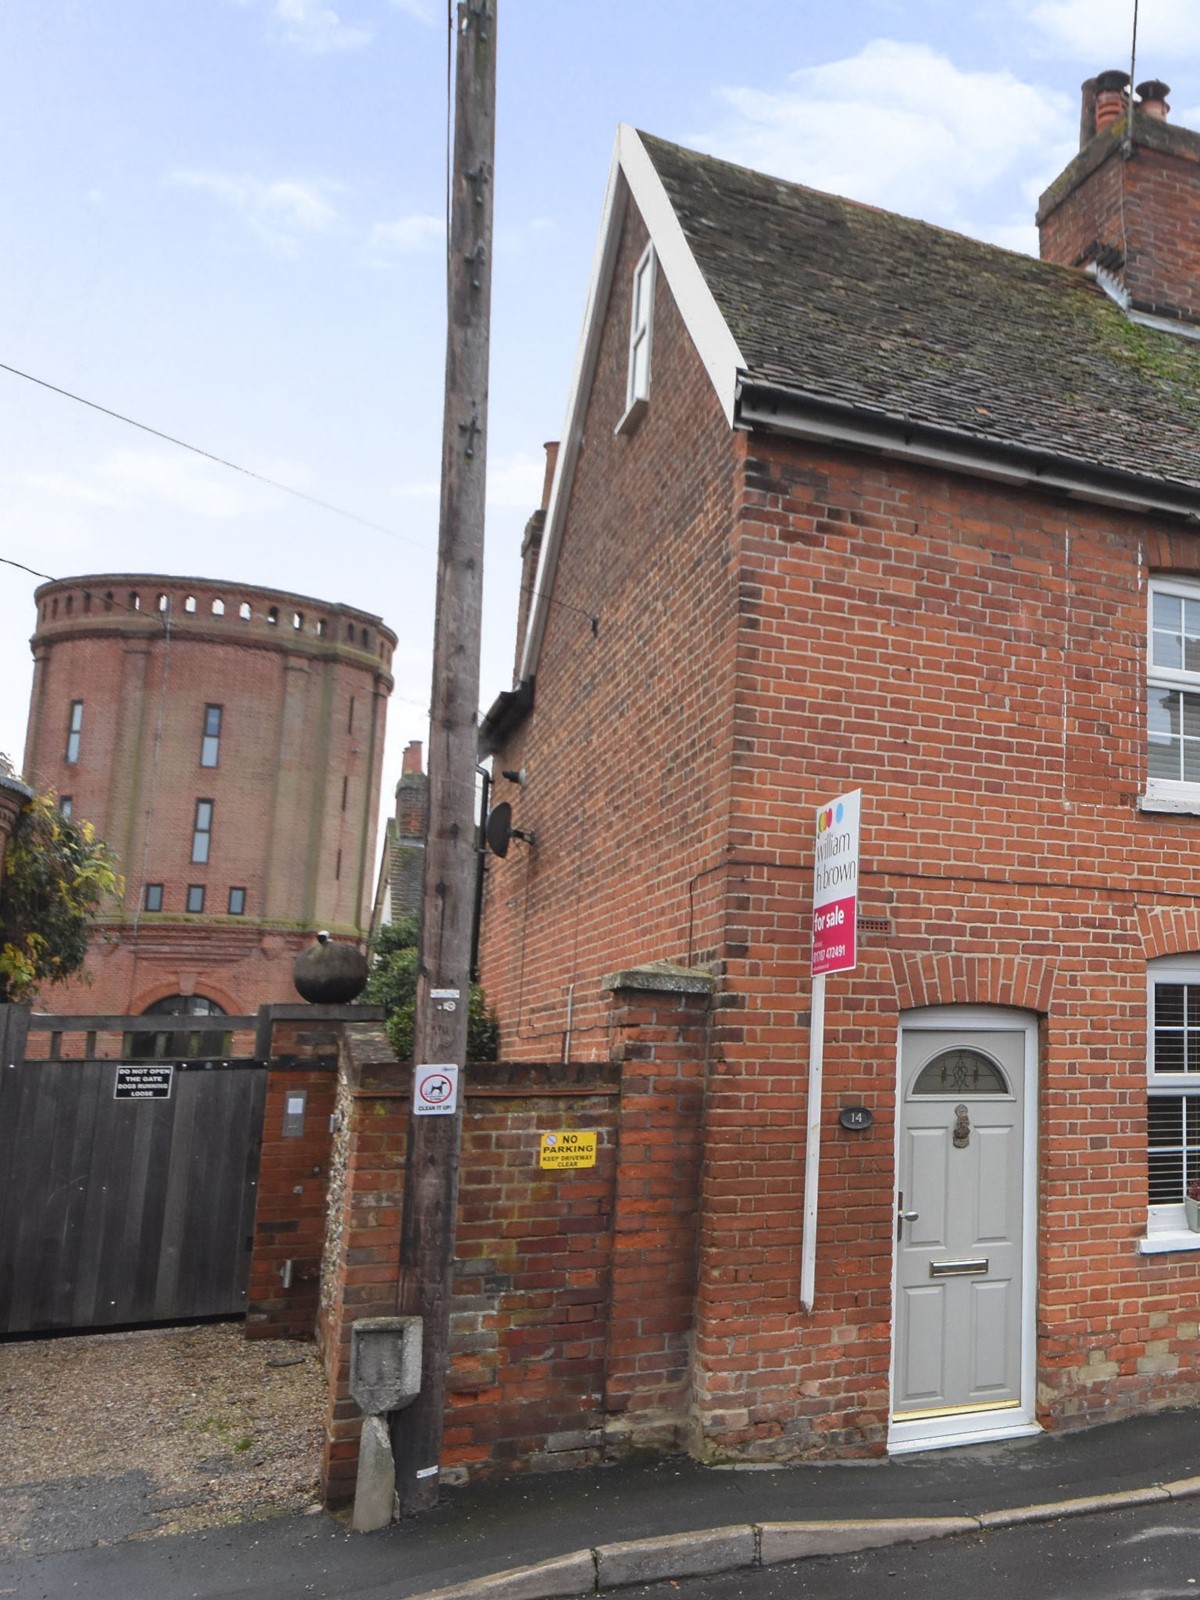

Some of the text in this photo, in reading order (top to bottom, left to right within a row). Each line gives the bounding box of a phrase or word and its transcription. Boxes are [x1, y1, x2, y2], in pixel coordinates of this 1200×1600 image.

[816, 833, 850, 862] william
[823, 860, 856, 890] brown
[814, 905, 845, 932] for sale
[851, 1112, 863, 1123] 14
[562, 1134, 578, 1144] NO
[543, 1145, 594, 1153] PARKING
